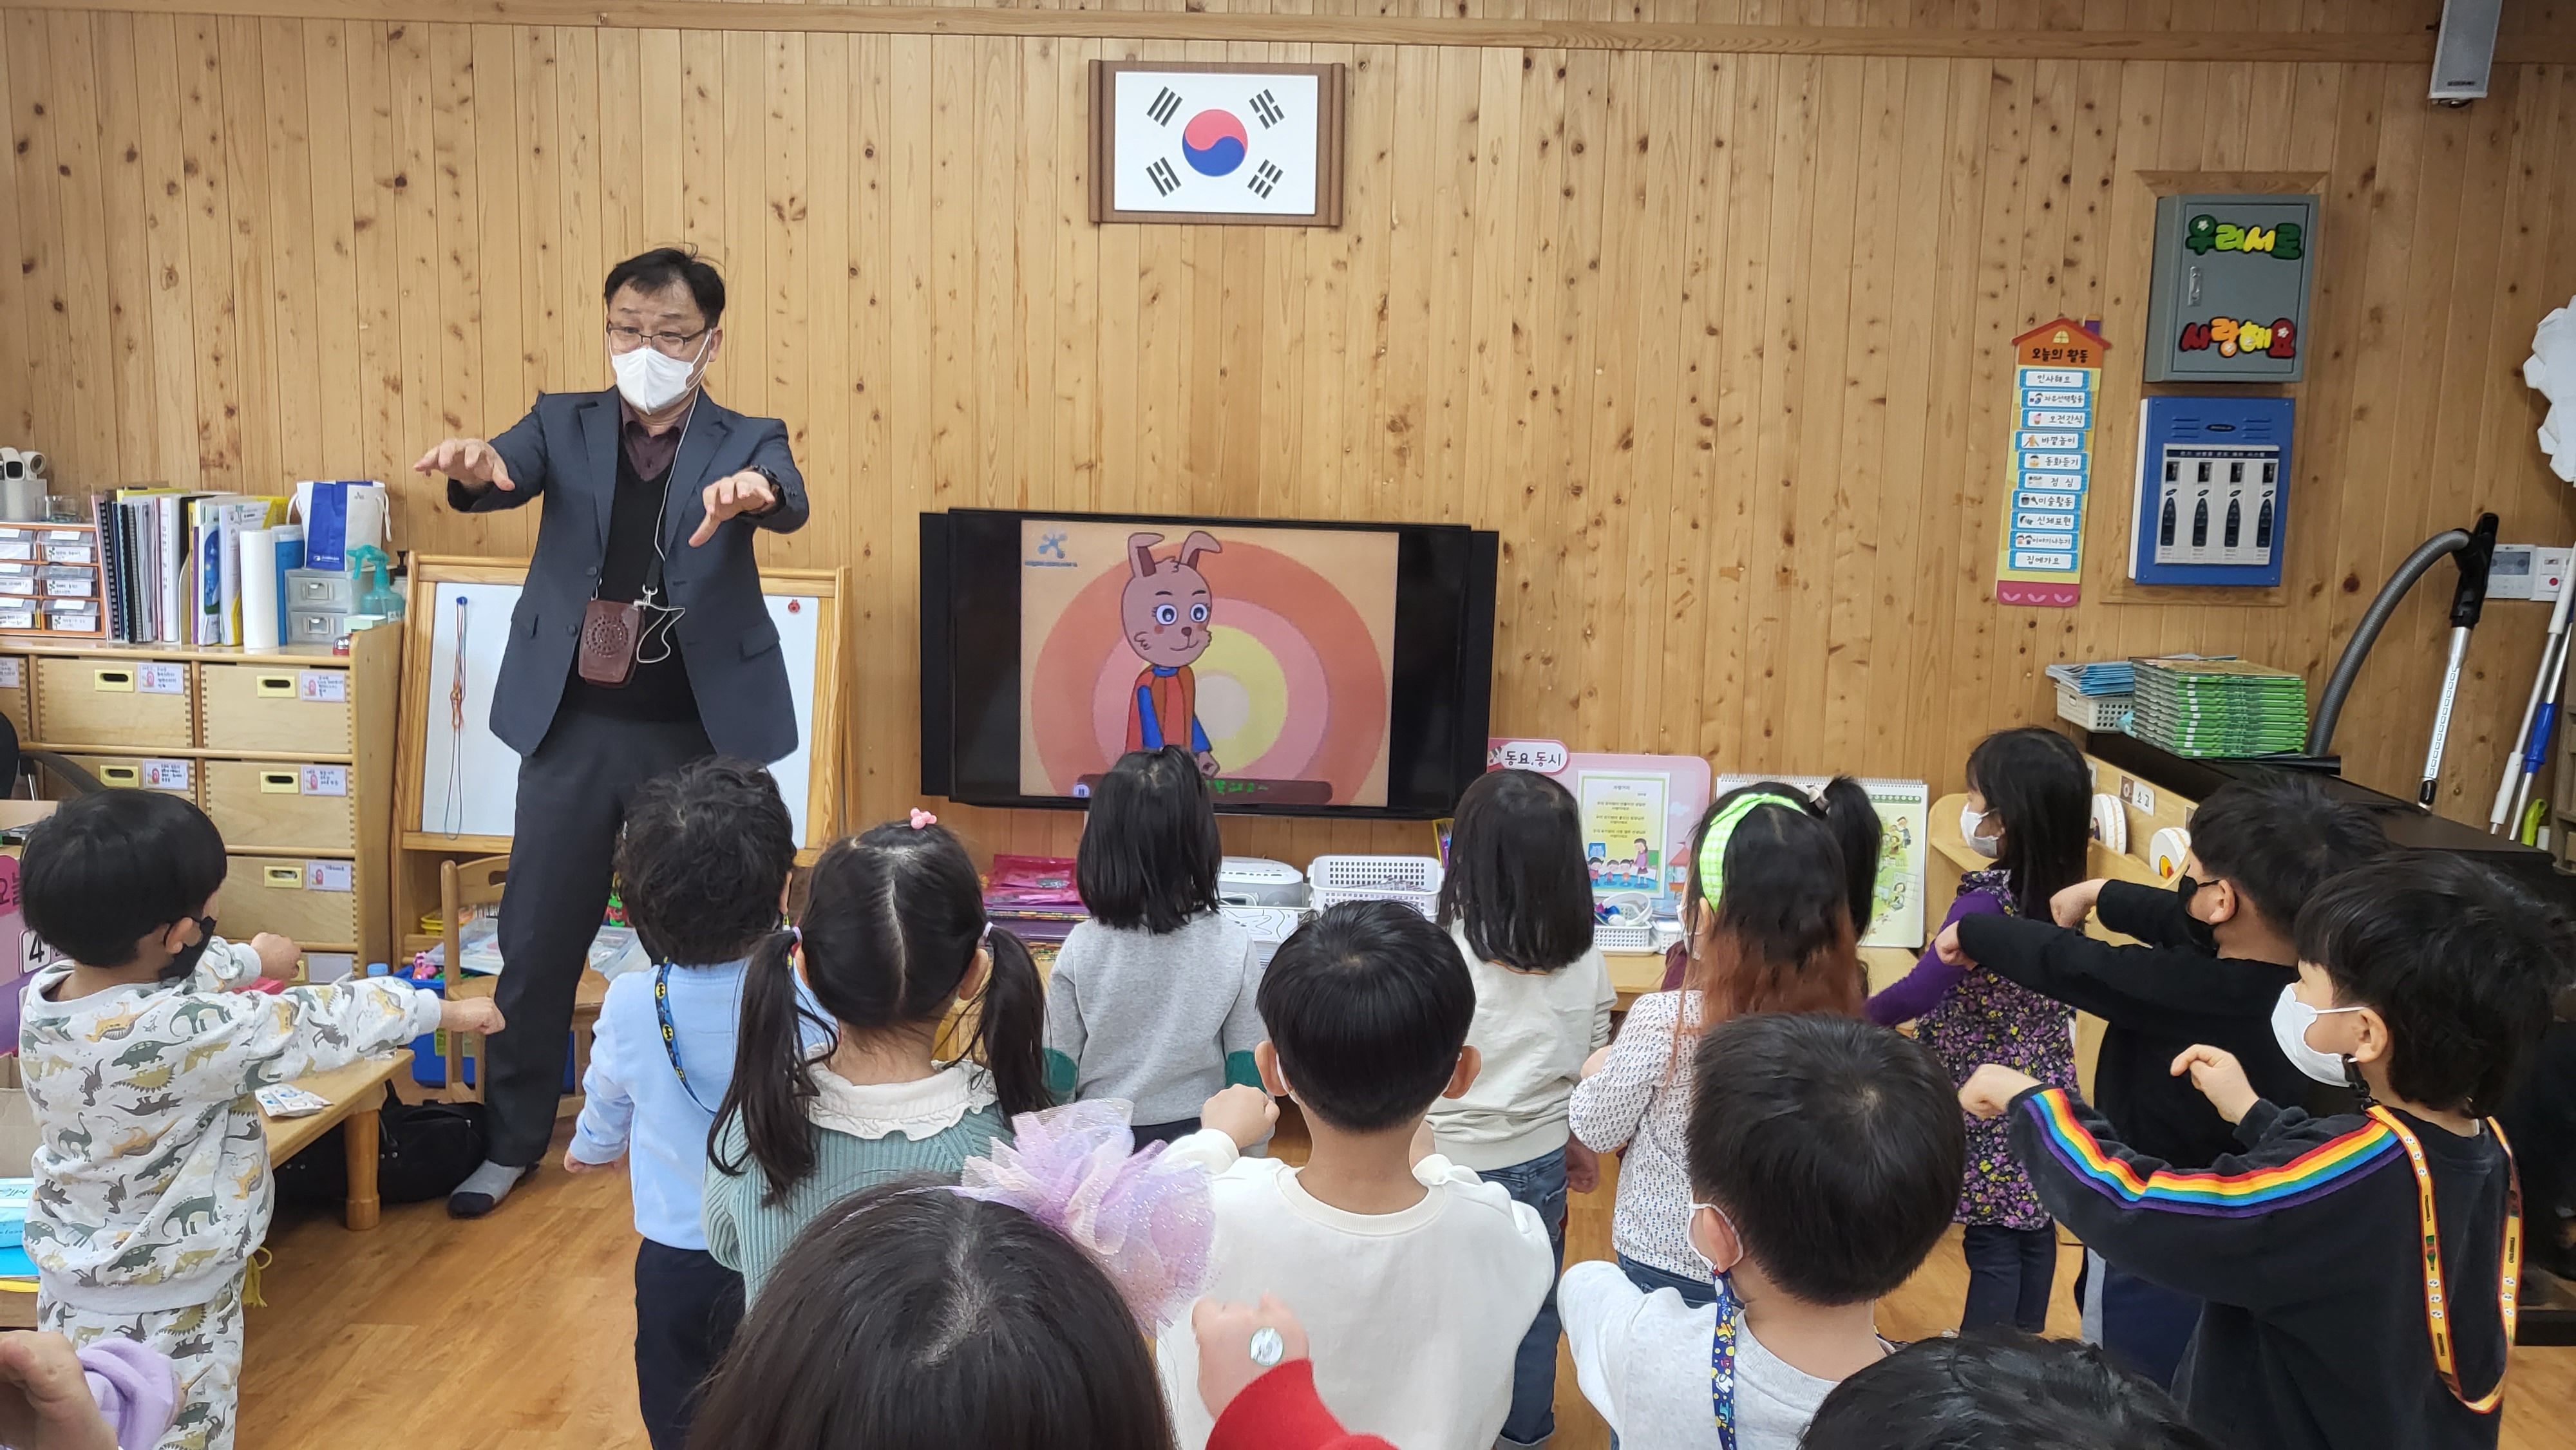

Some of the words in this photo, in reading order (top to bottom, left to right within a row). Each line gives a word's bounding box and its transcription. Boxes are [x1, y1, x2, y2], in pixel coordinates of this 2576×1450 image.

[2186, 214, 2302, 260] 우리서로
[2179, 316, 2295, 358] 사랑해요
[2032, 348, 2063, 362] 오늘의
[2067, 349, 2088, 363] 활동
[2037, 374, 2072, 384] 인사해요
[2049, 415, 2083, 424] 오전간식
[2041, 436, 2075, 446] 바깥놀이
[2045, 457, 2078, 467] 동화듣기
[2038, 496, 2072, 507] 미술활동
[2037, 516, 2071, 527] 신체표현
[2027, 555, 2060, 565] 집에가요
[29, 935, 45, 963] 4
